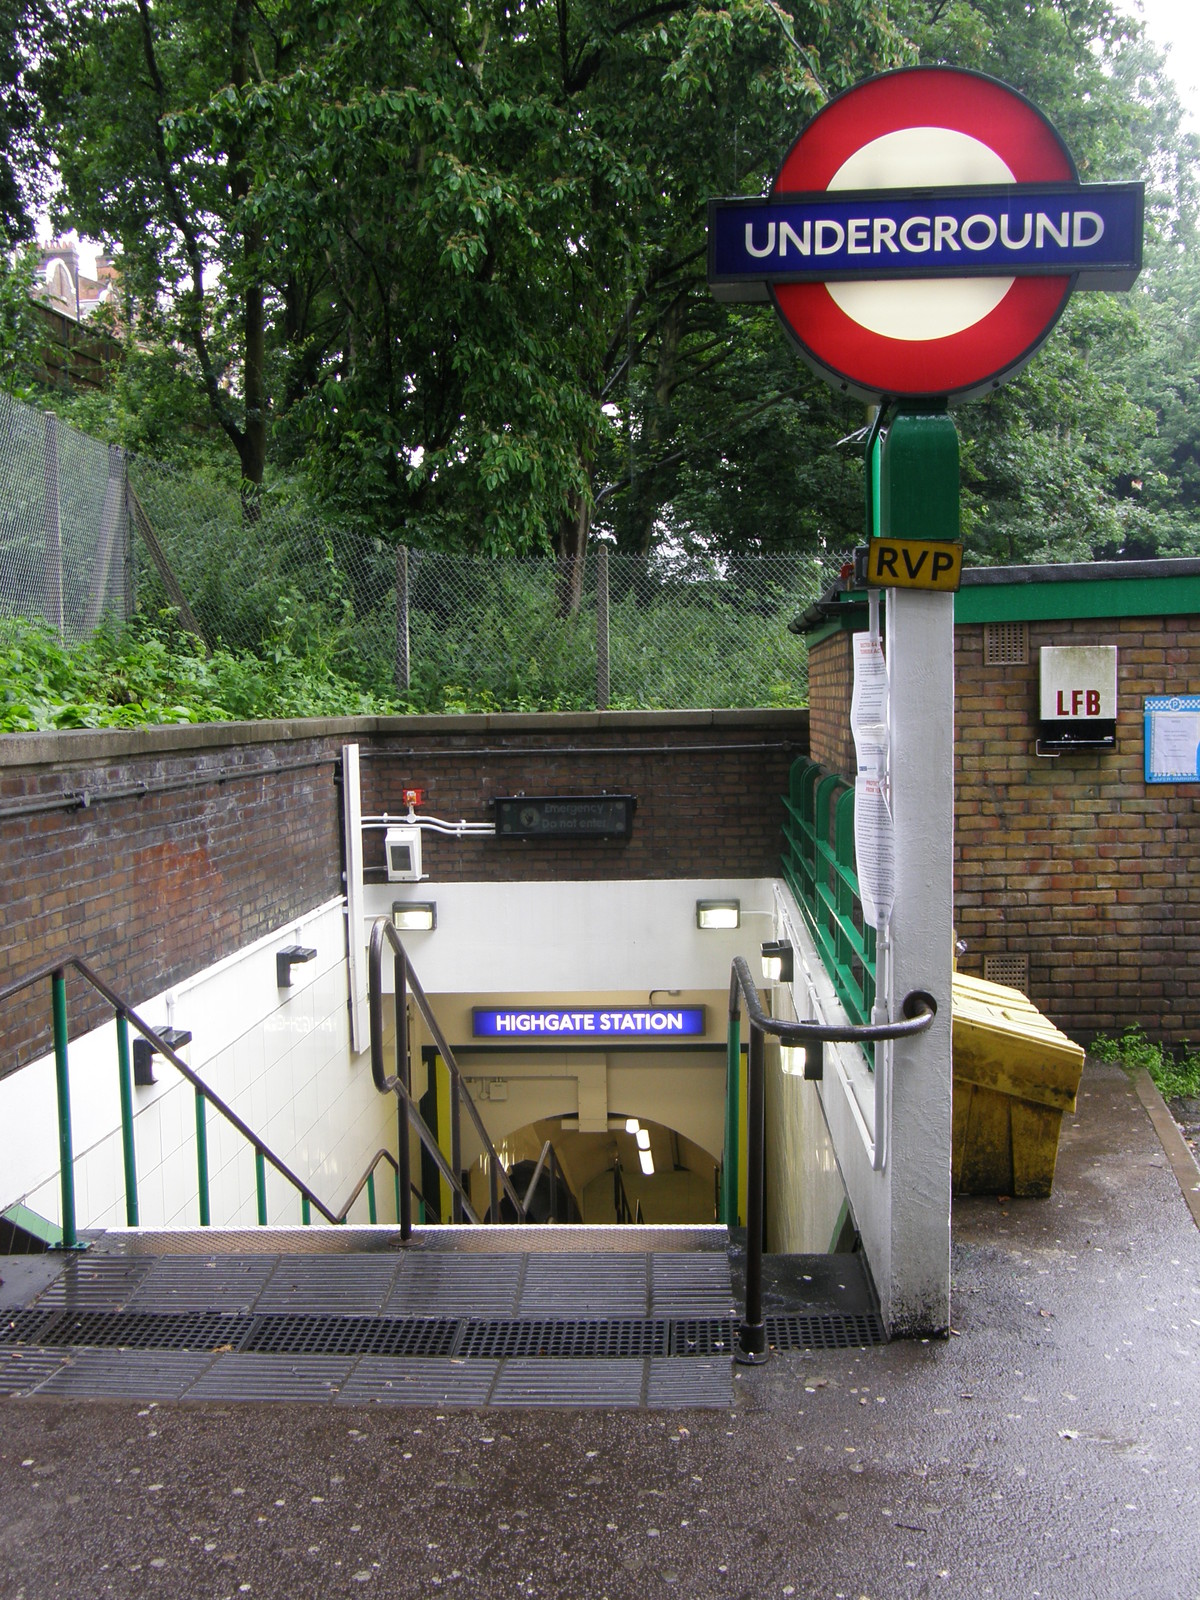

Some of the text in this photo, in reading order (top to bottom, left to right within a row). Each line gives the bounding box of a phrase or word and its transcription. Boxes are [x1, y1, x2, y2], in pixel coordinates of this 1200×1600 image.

[745, 210, 1105, 258] UNDERGROUND
[876, 546, 954, 581] RVP
[1057, 690, 1101, 716] LFB
[544, 803, 604, 816] Emergency
[542, 818, 557, 829] Do
[560, 818, 577, 828] not
[496, 1013, 683, 1031] HIGHGATE STATION
